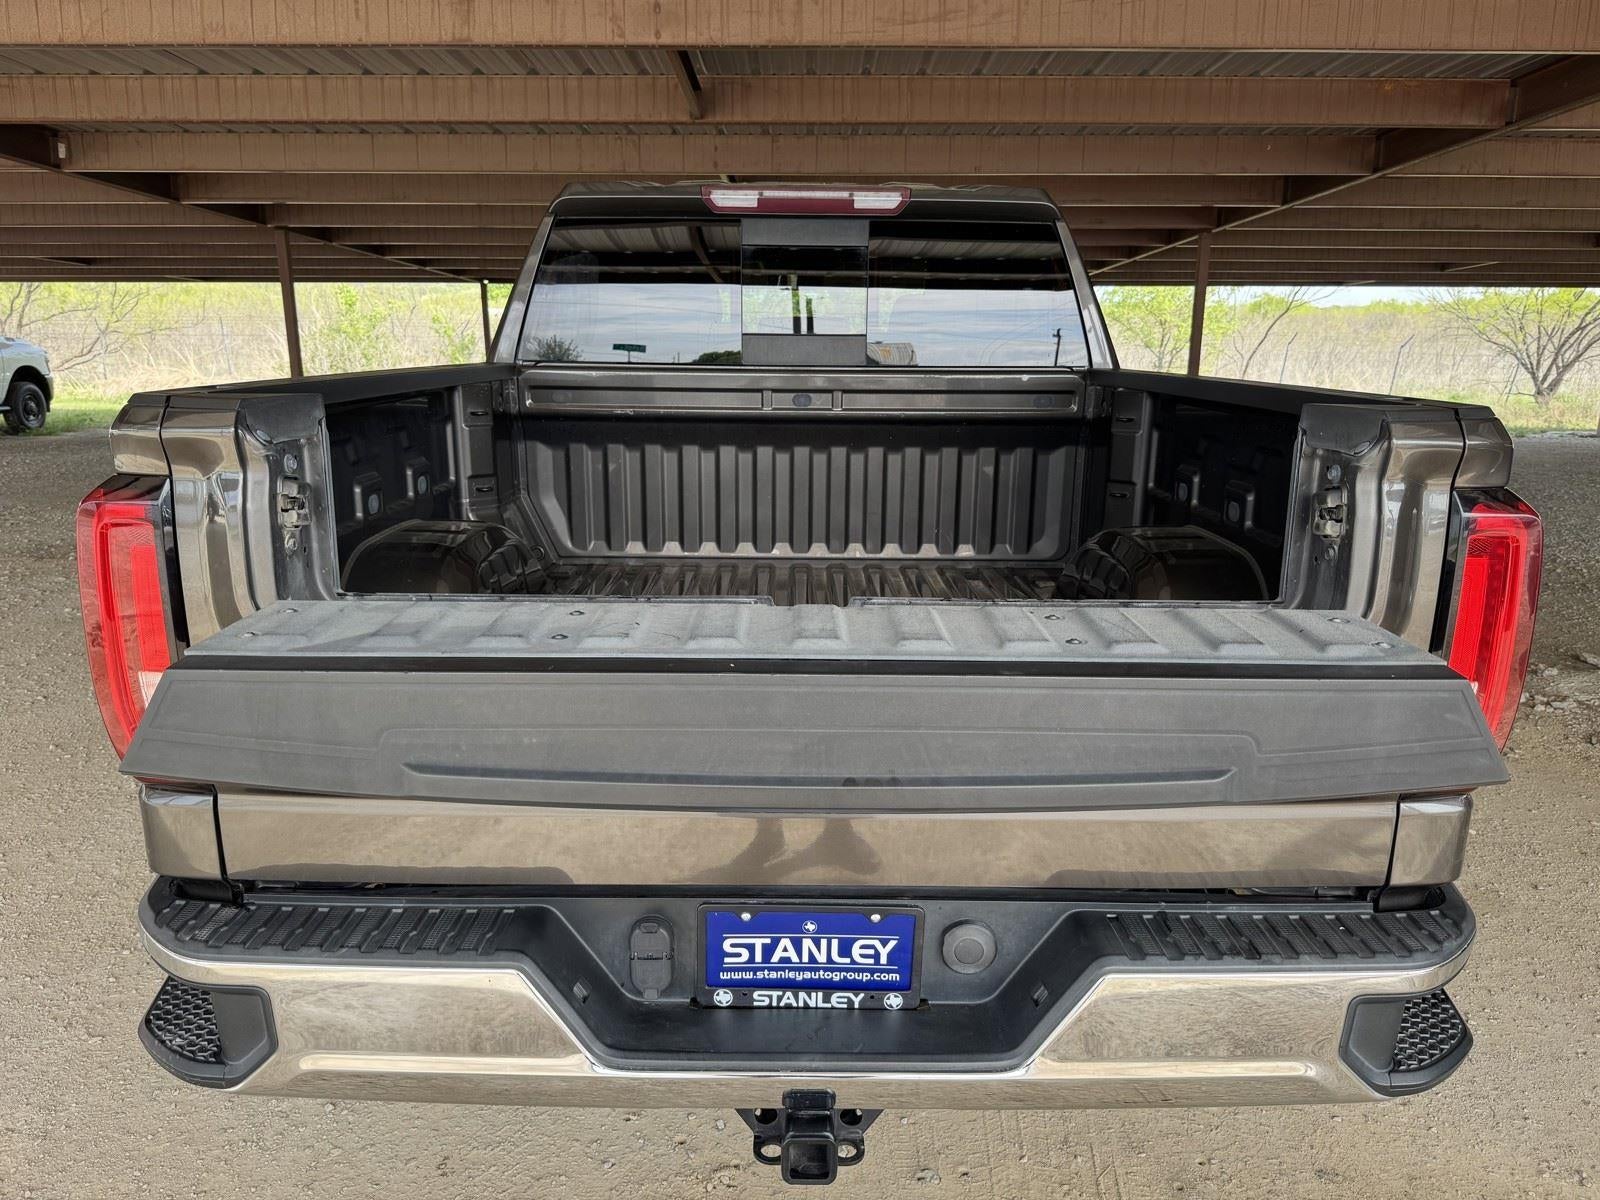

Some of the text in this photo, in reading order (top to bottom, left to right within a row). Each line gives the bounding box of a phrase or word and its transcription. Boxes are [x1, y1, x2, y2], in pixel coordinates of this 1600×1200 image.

[722, 937, 899, 965] STANLEY
[719, 968, 900, 982] www.stanleyautogroup.com
[752, 990, 865, 1009] STANLEY
